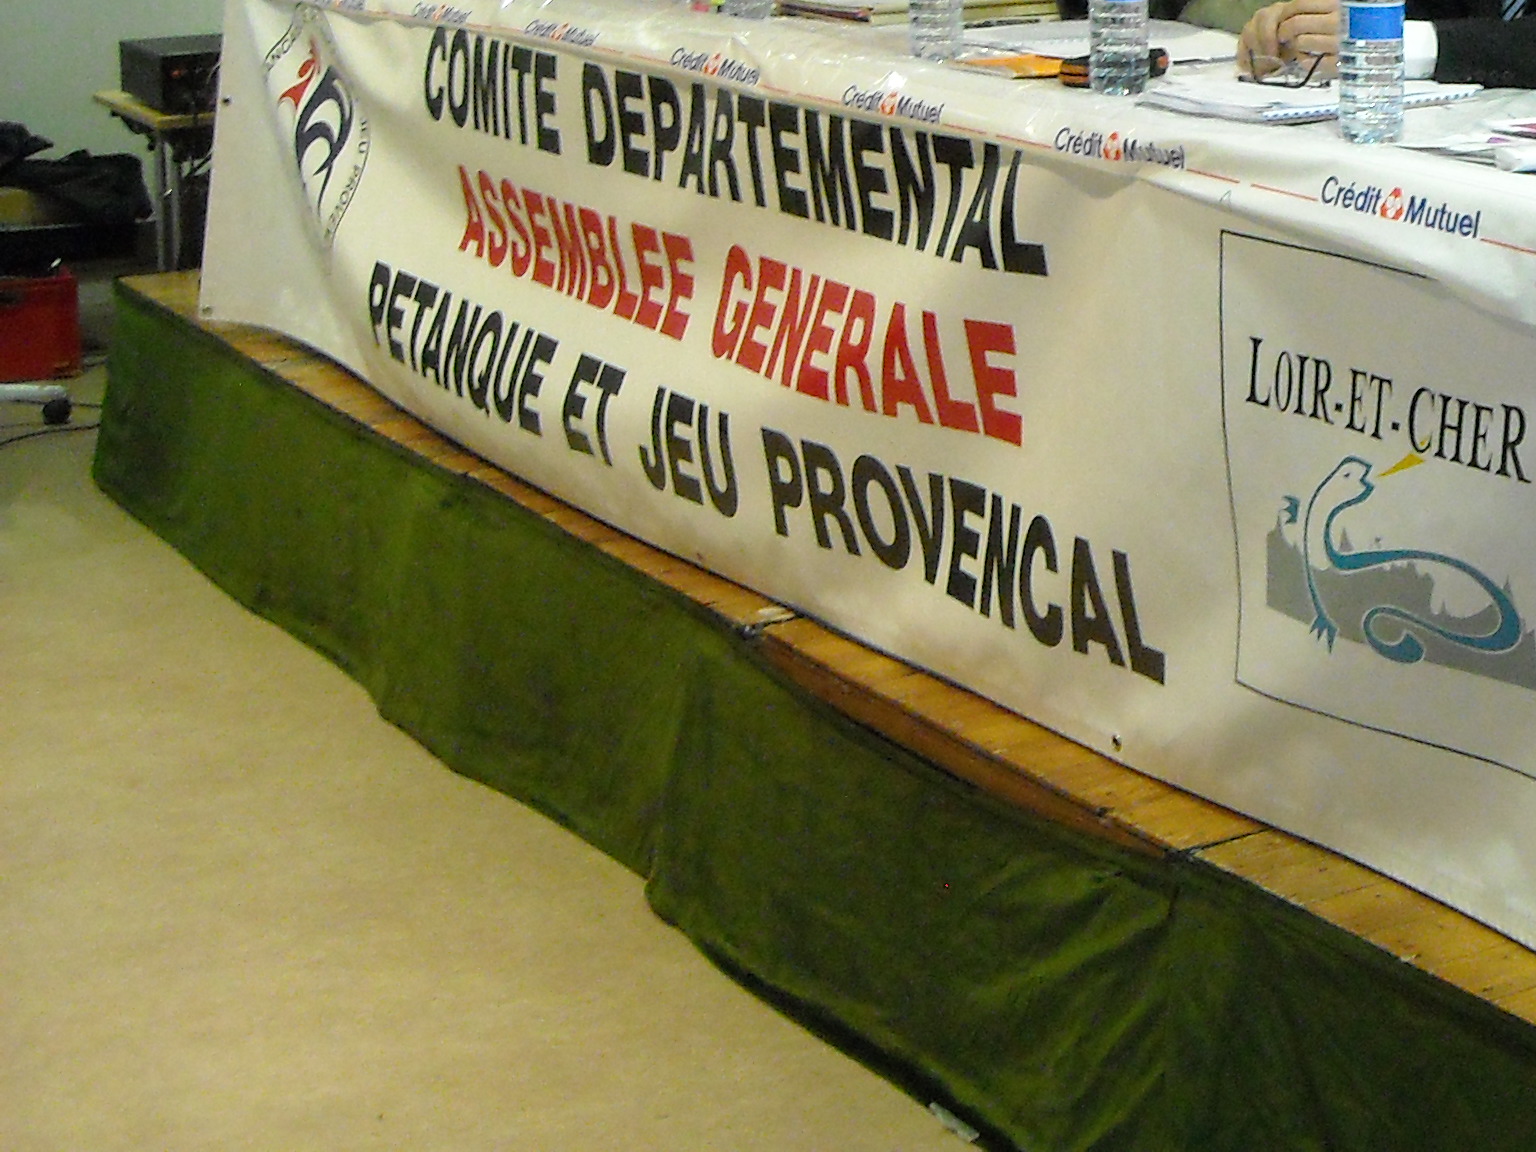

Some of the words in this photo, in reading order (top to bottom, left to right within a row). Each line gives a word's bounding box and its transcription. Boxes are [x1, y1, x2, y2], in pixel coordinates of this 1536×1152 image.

[669, 47, 706, 74] Crédit
[842, 85, 884, 113] Crédit
[895, 95, 945, 125] Mutuel
[424, 26, 562, 155] COMITE
[581, 62, 1049, 277] DEPARTEMENTAL
[1055, 127, 1104, 158] Crédit
[1320, 175, 1384, 217] Crédit
[1404, 198, 1481, 239] Mutuel
[457, 164, 696, 342] ASSEMBLEE
[711, 244, 1023, 447] GENERALE
[1245, 336, 1532, 484] LOIR-ET-CHER
[368, 261, 560, 436] PETANQUE
[562, 353, 627, 467] ET
[638, 387, 739, 518] JEU
[761, 427, 1167, 686] PROVENCAL
